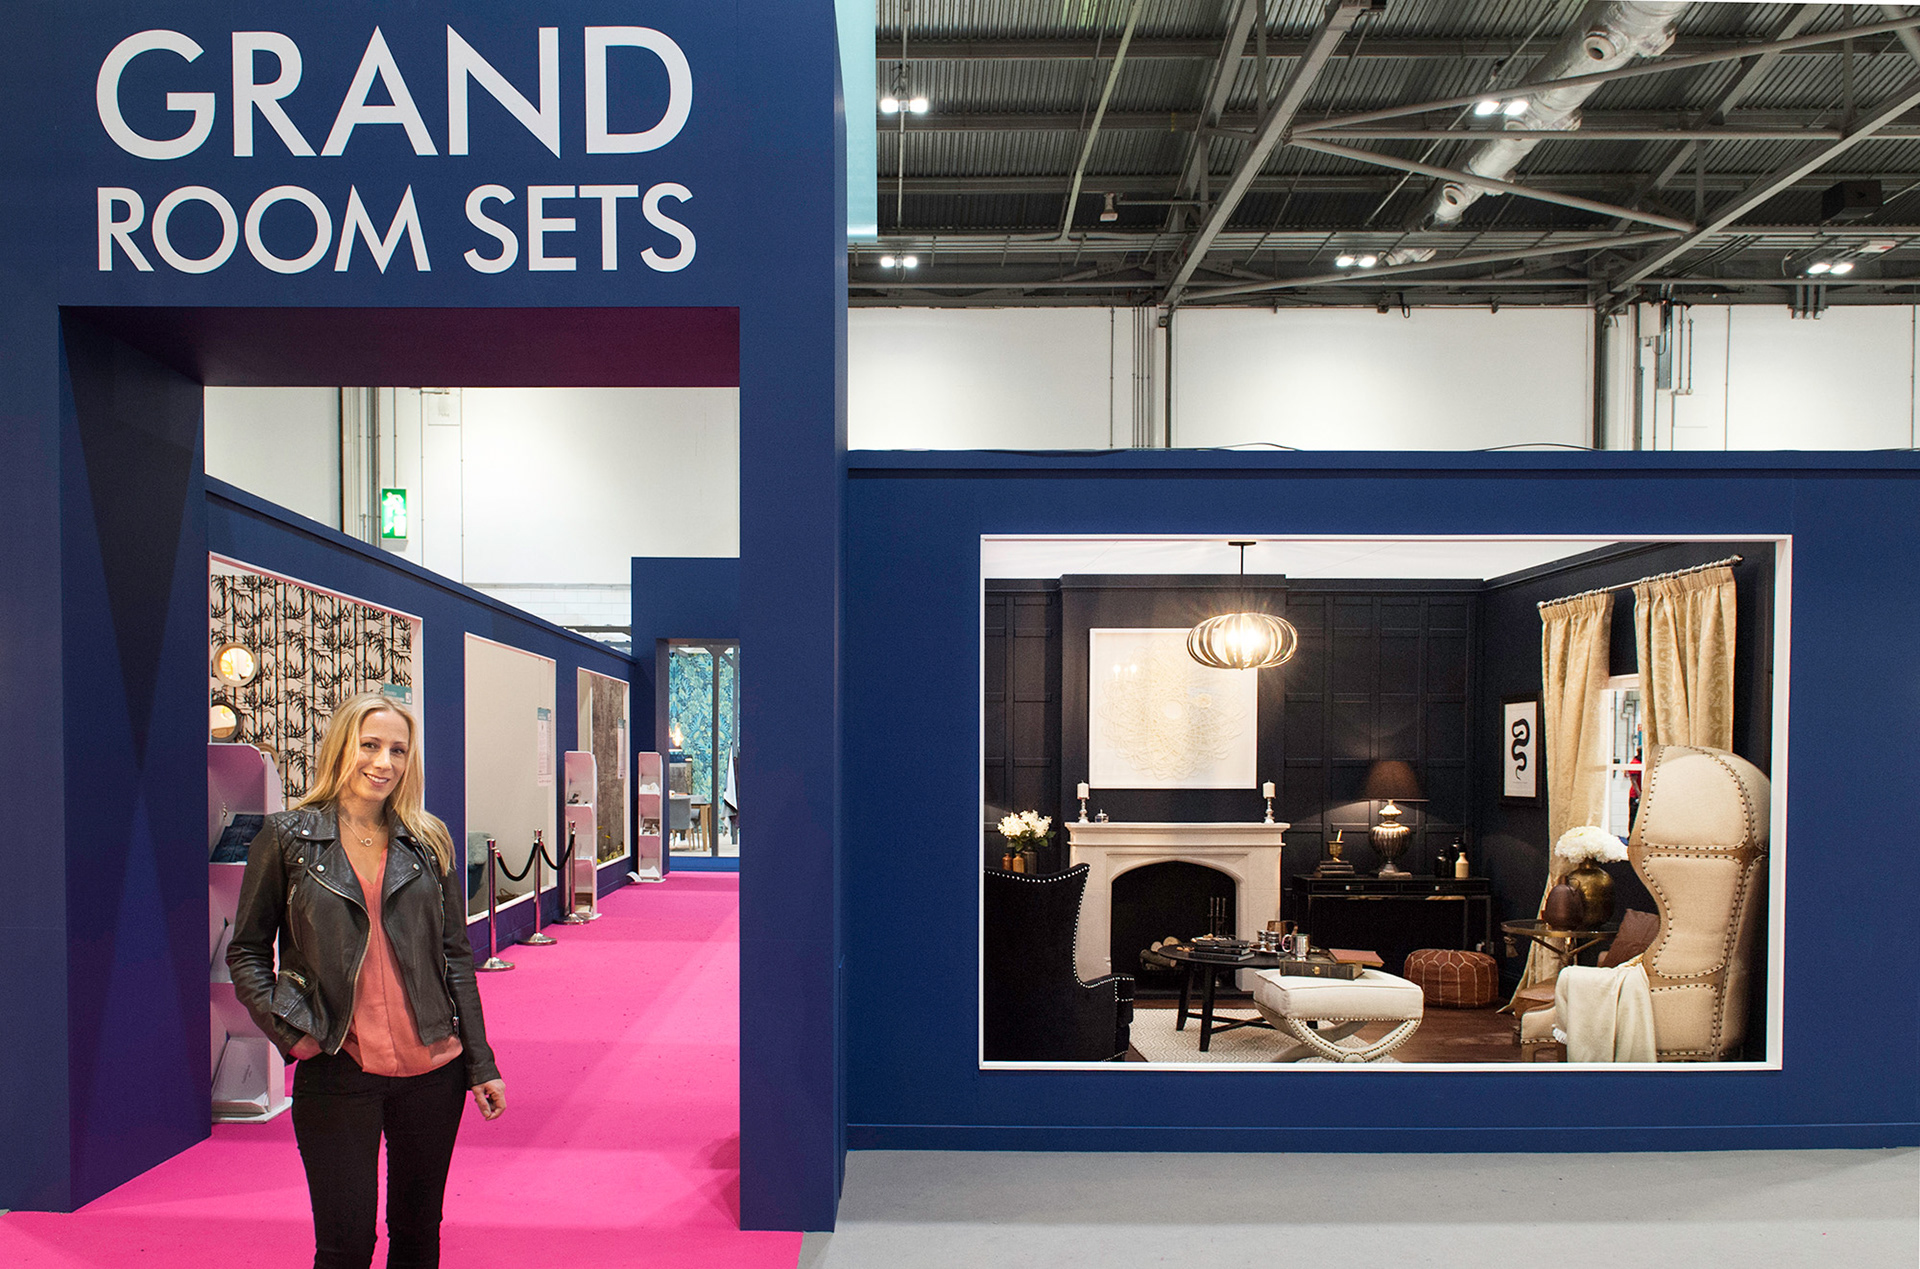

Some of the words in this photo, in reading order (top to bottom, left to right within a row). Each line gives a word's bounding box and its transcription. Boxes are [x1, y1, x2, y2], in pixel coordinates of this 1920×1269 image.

[95, 25, 694, 160] GRAND
[97, 184, 432, 275] ROOM
[463, 182, 697, 275] SETS
